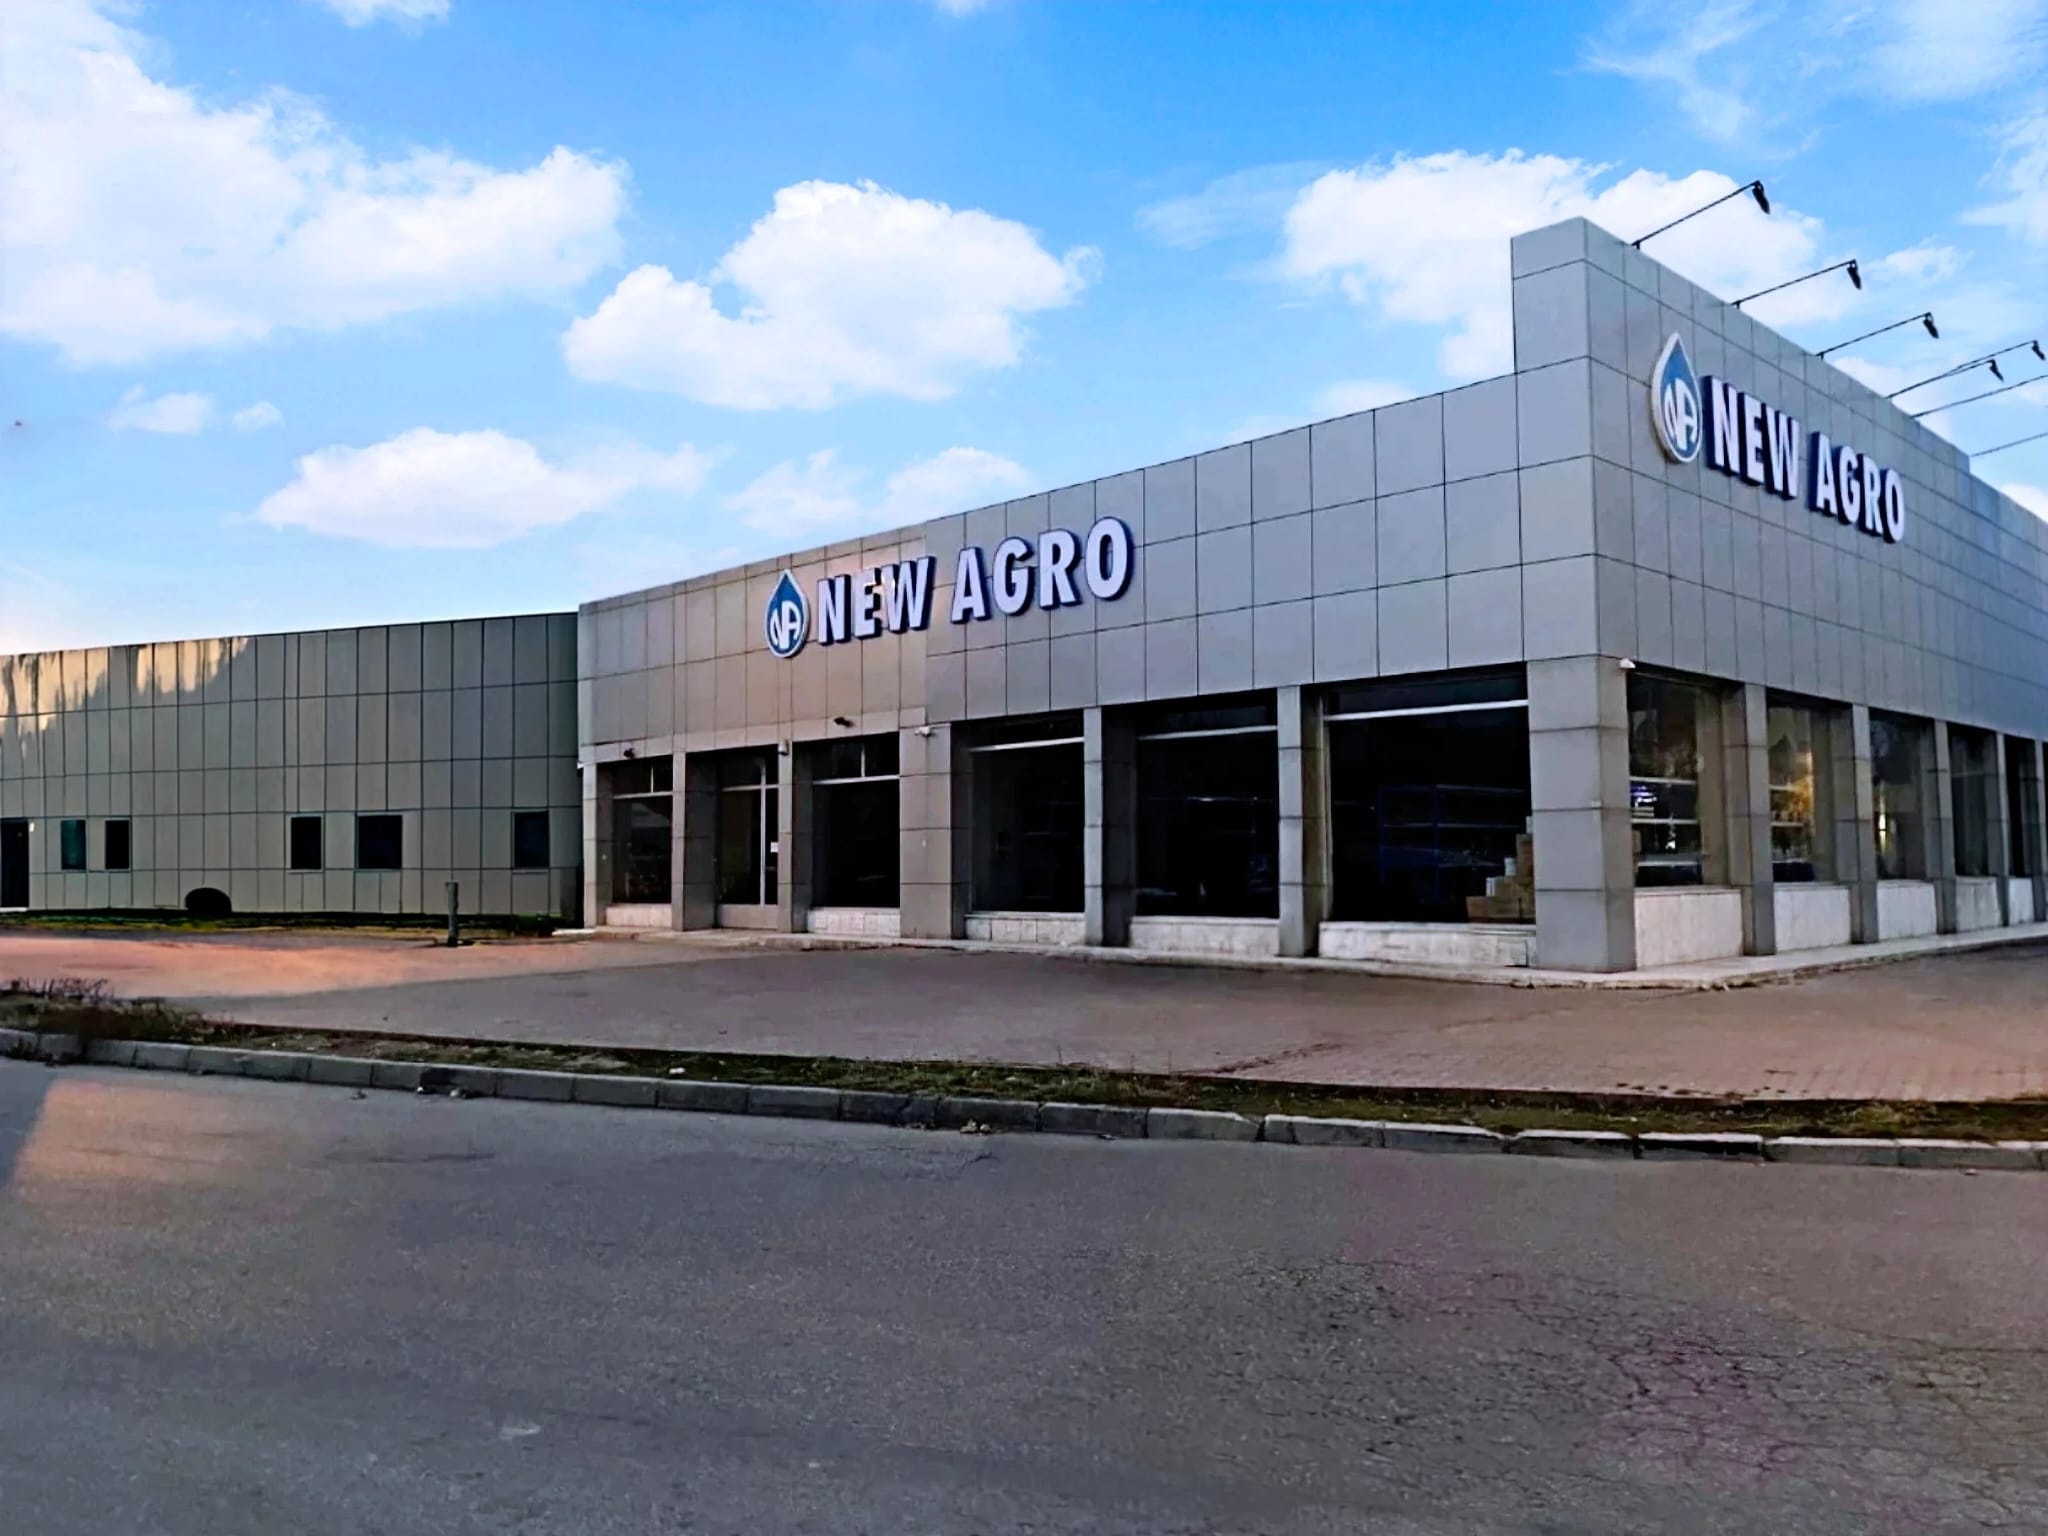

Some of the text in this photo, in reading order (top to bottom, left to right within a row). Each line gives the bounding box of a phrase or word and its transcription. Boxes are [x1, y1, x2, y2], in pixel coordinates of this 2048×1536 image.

[1706, 376, 1905, 543] NEW AGRO
[817, 516, 1134, 645] NEW AGRO
